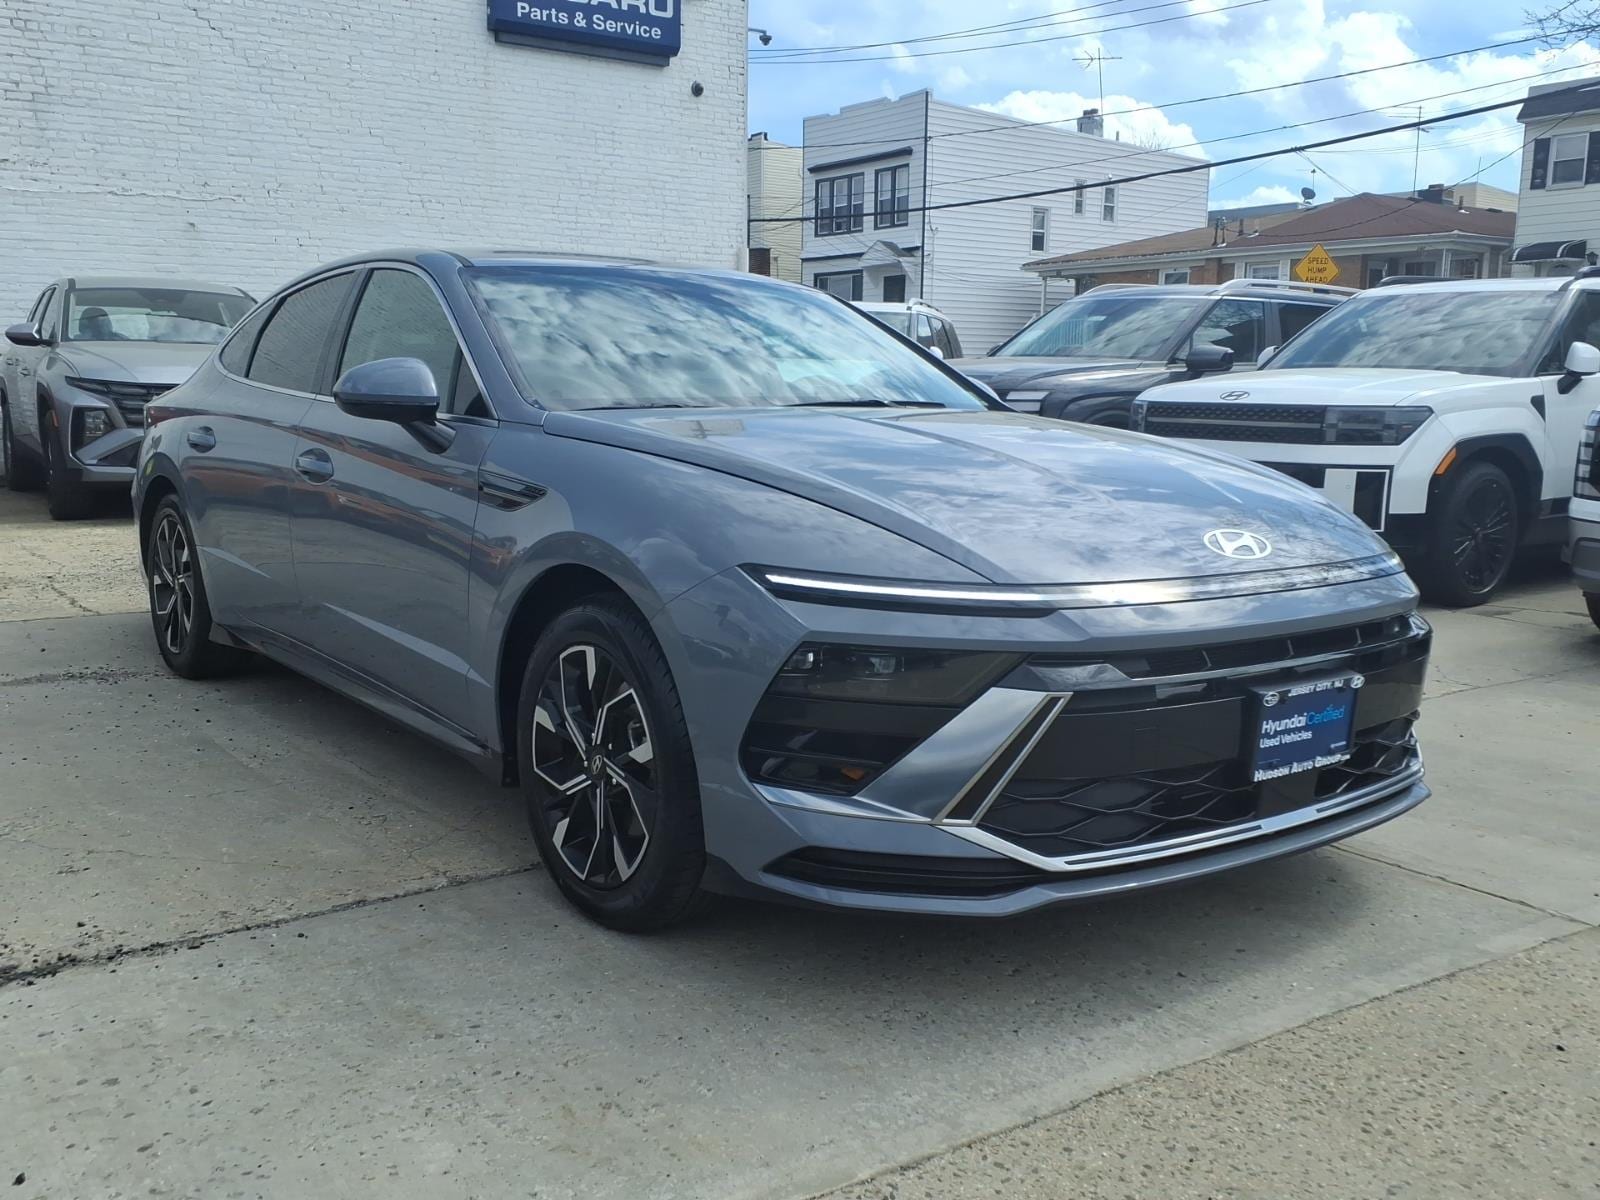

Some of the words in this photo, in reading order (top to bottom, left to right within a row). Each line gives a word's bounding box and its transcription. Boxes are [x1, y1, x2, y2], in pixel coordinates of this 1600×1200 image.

[517, 2, 569, 24] Parts
[574, 12, 587, 27] &
[592, 14, 662, 39] Service
[1260, 736, 1280, 748] Used
[1281, 731, 1313, 744] Vehicles
